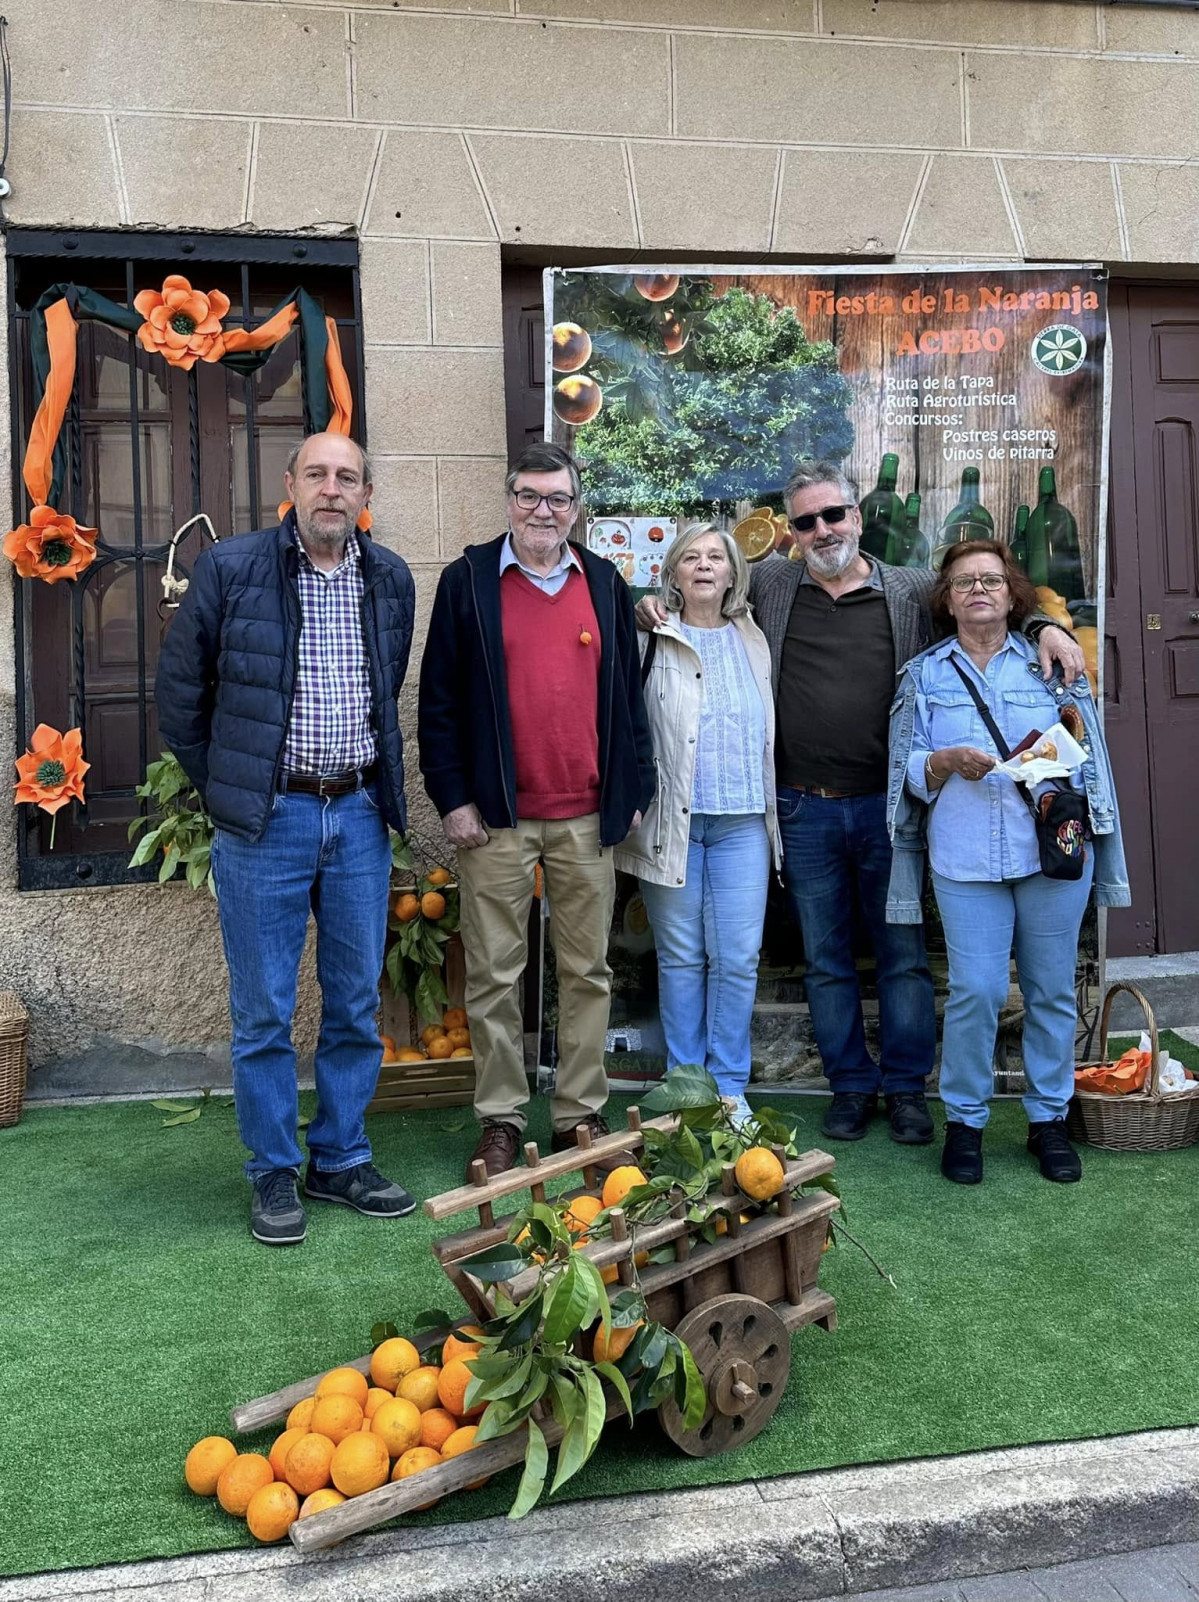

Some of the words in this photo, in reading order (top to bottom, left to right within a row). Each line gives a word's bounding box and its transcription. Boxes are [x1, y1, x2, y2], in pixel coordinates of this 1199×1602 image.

[807, 290, 894, 316] Fiesta
[901, 289, 937, 314] de
[944, 288, 970, 313] la
[978, 285, 1099, 315] Naranja
[896, 327, 1005, 356] ACEBO
[886, 377, 919, 391] Ruta
[922, 376, 940, 390] de
[944, 376, 956, 390] la
[960, 375, 994, 389] Tapa
[886, 394, 919, 408] Ruta
[923, 391, 1017, 408] Agroturística
[884, 412, 963, 426] Concursos:
[942, 429, 998, 443] Postres
[1002, 429, 1057, 441] caseros
[942, 447, 984, 462] Vinos
[987, 445, 1006, 460] de
[1009, 445, 1055, 460] pitarra
